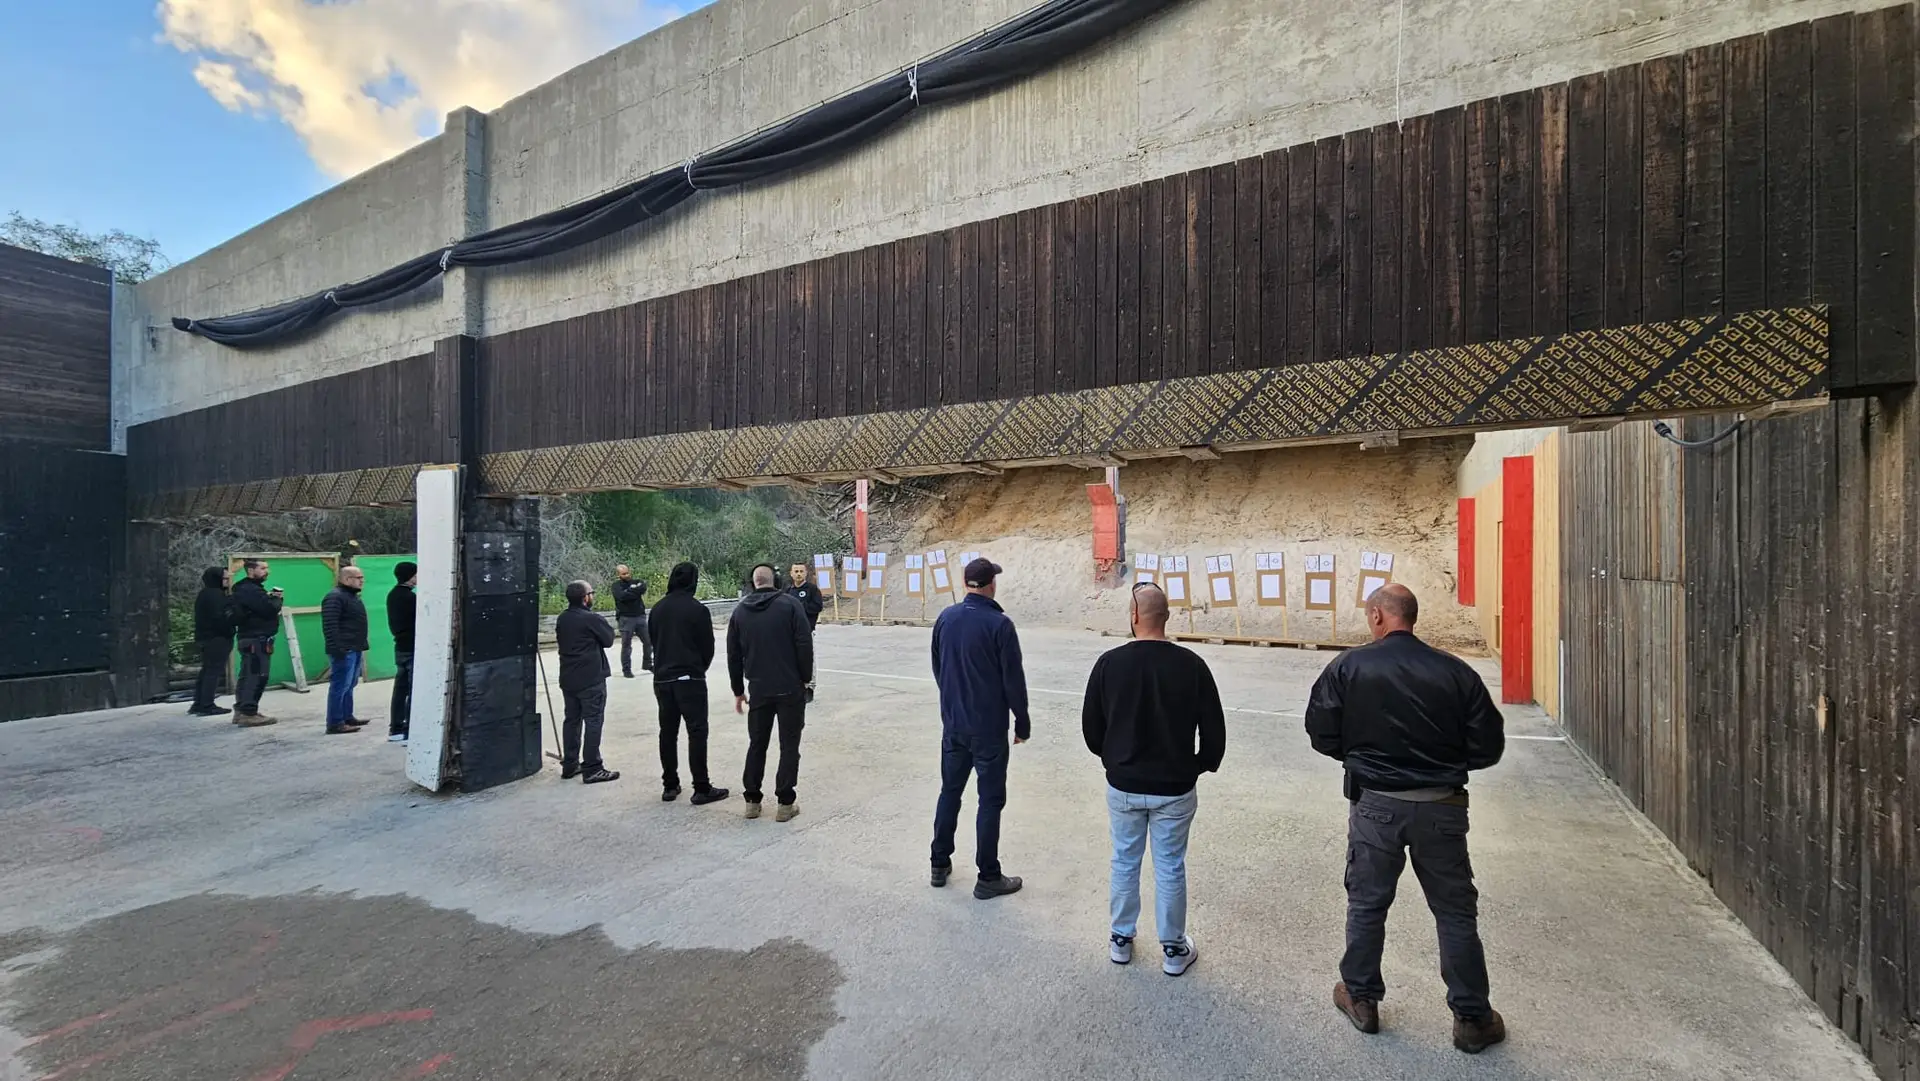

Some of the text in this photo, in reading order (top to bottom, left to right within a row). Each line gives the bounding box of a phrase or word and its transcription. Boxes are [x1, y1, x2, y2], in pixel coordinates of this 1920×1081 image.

[1630, 326, 1676, 357] MARIN
[1718, 322, 1812, 386] MARINEPLEX
[1732, 314, 1827, 374] MARINEPLEX
[1756, 311, 1828, 360] ARINEPL
[1426, 350, 1487, 394] MARINEPL
[1470, 345, 1509, 373] MARIN
[1533, 352, 1611, 411] MARINEPLEX
[1544, 342, 1624, 401] MARINEPLEX
[1556, 335, 1636, 390] MARINEPLEX
[1676, 357, 1747, 402] RINEPLEX
[1690, 346, 1778, 400] ARINEPLEX
[1704, 334, 1796, 397] MARINEPLEX
[1181, 379, 1227, 417] MARINEPL
[1295, 366, 1348, 406] MARINEPL
[1368, 387, 1419, 427] RINEPLEX
[1387, 368, 1454, 423] MARINEPLEX
[1397, 358, 1465, 413] MARINEPLEX
[1487, 394, 1520, 419] 20MM
[1498, 383, 1547, 417] NEPLEX
[1510, 373, 1570, 416] RINEPLEX
[1358, 397, 1399, 429] NEPLEX
